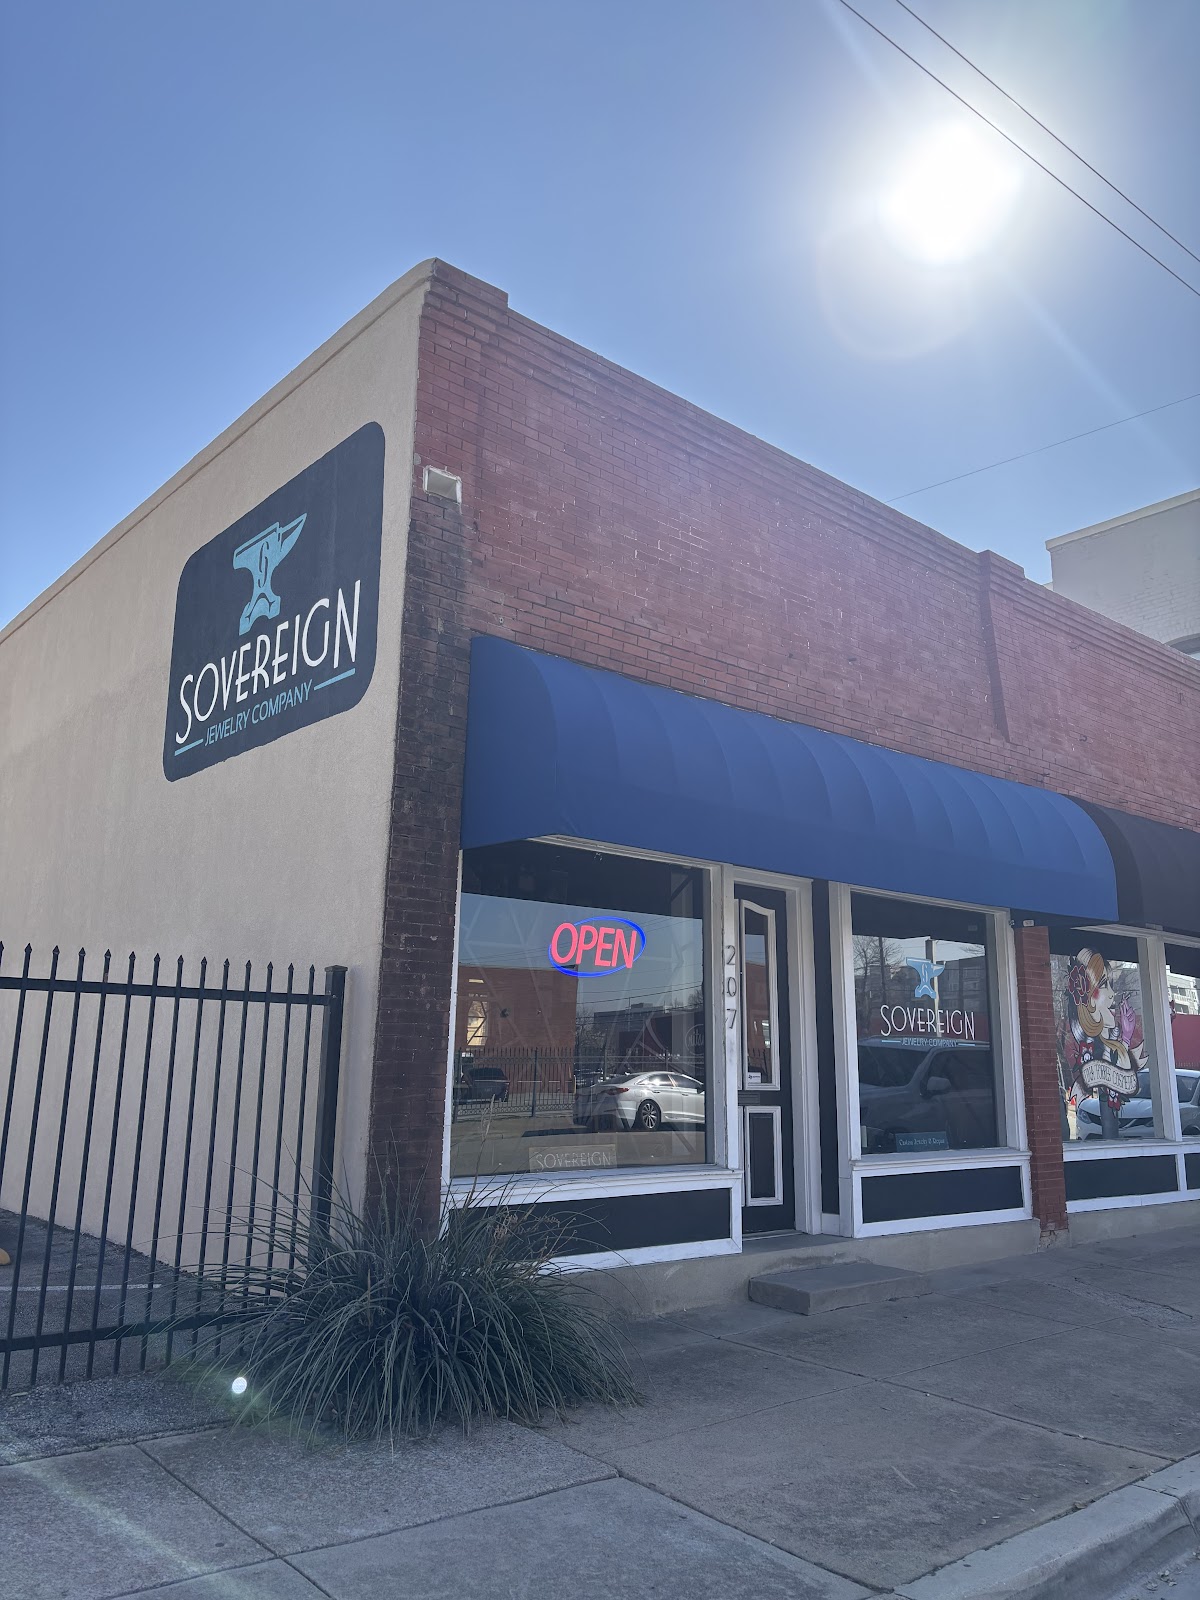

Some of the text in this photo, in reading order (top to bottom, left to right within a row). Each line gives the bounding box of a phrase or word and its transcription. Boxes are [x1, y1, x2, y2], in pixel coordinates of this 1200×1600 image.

[175, 579, 361, 744] SOVEREIGN
[204, 679, 313, 747] JEWELRY COMPANY
[551, 922, 637, 969] OPEN
[726, 945, 737, 1030] 207
[880, 1004, 975, 1040] SOVEREIGN
[901, 1037, 958, 1048] JEWELRY COMPANY
[536, 1151, 611, 1172] SOVEREIGN
